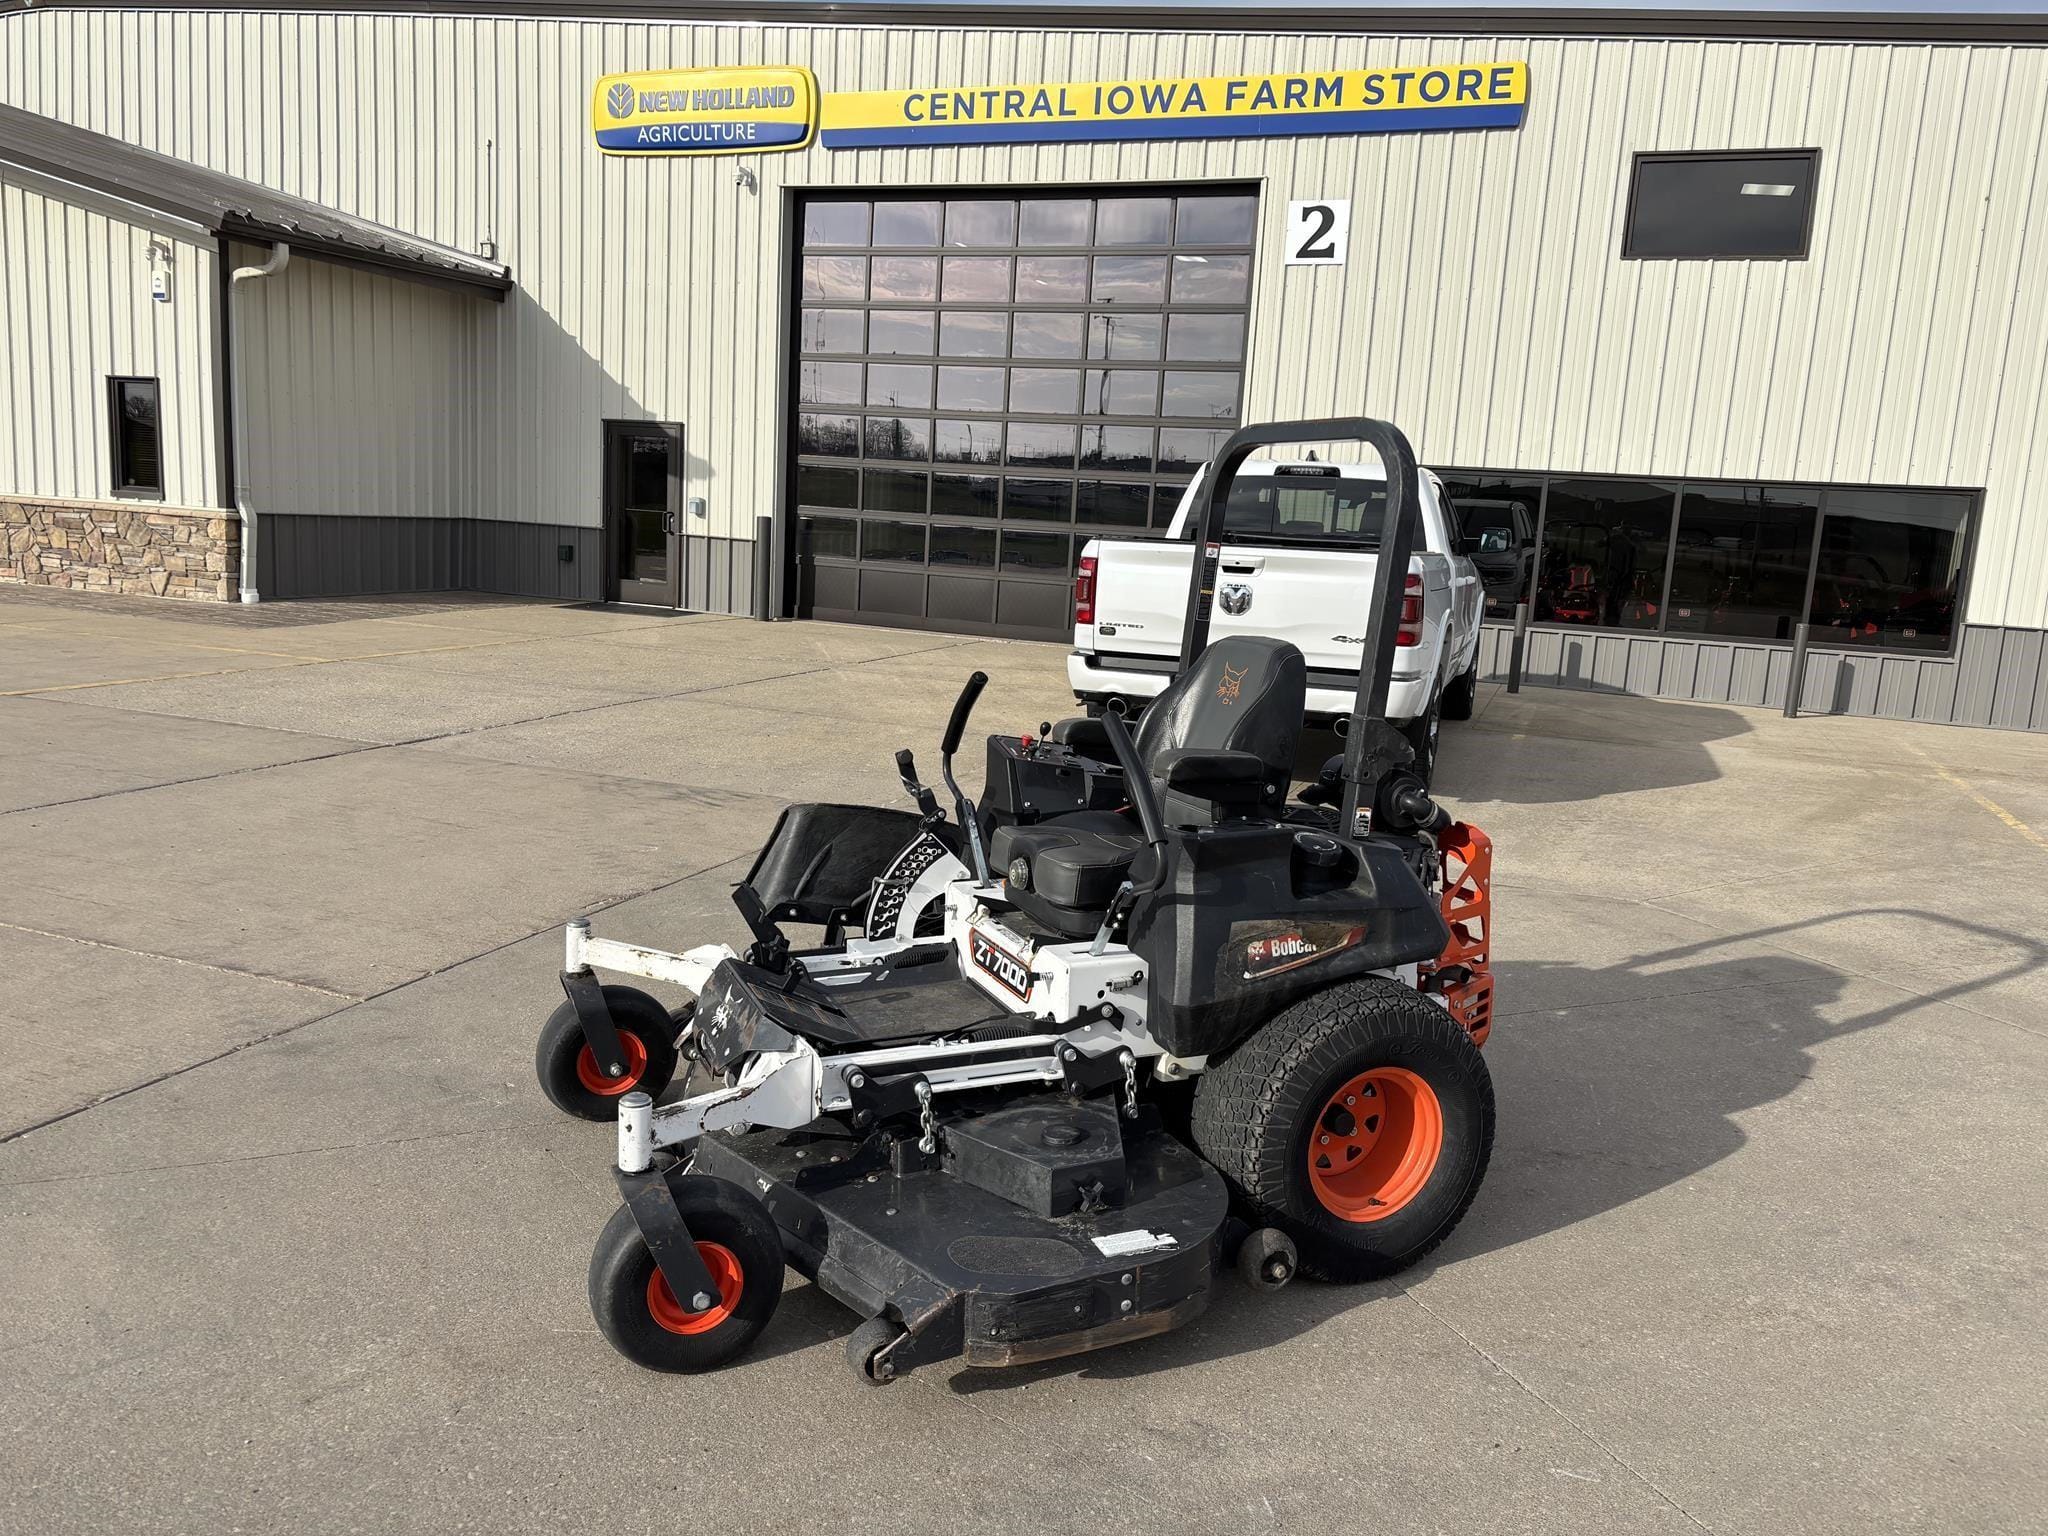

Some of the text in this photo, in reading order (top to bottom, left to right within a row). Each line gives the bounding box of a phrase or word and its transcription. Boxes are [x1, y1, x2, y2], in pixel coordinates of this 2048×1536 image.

[639, 86, 795, 113] NEW HOLLAND
[904, 67, 1514, 121] CENTRAL IOWA FARM STORE
[637, 123, 756, 143] AGRICULTURE
[1296, 205, 1335, 258] 2
